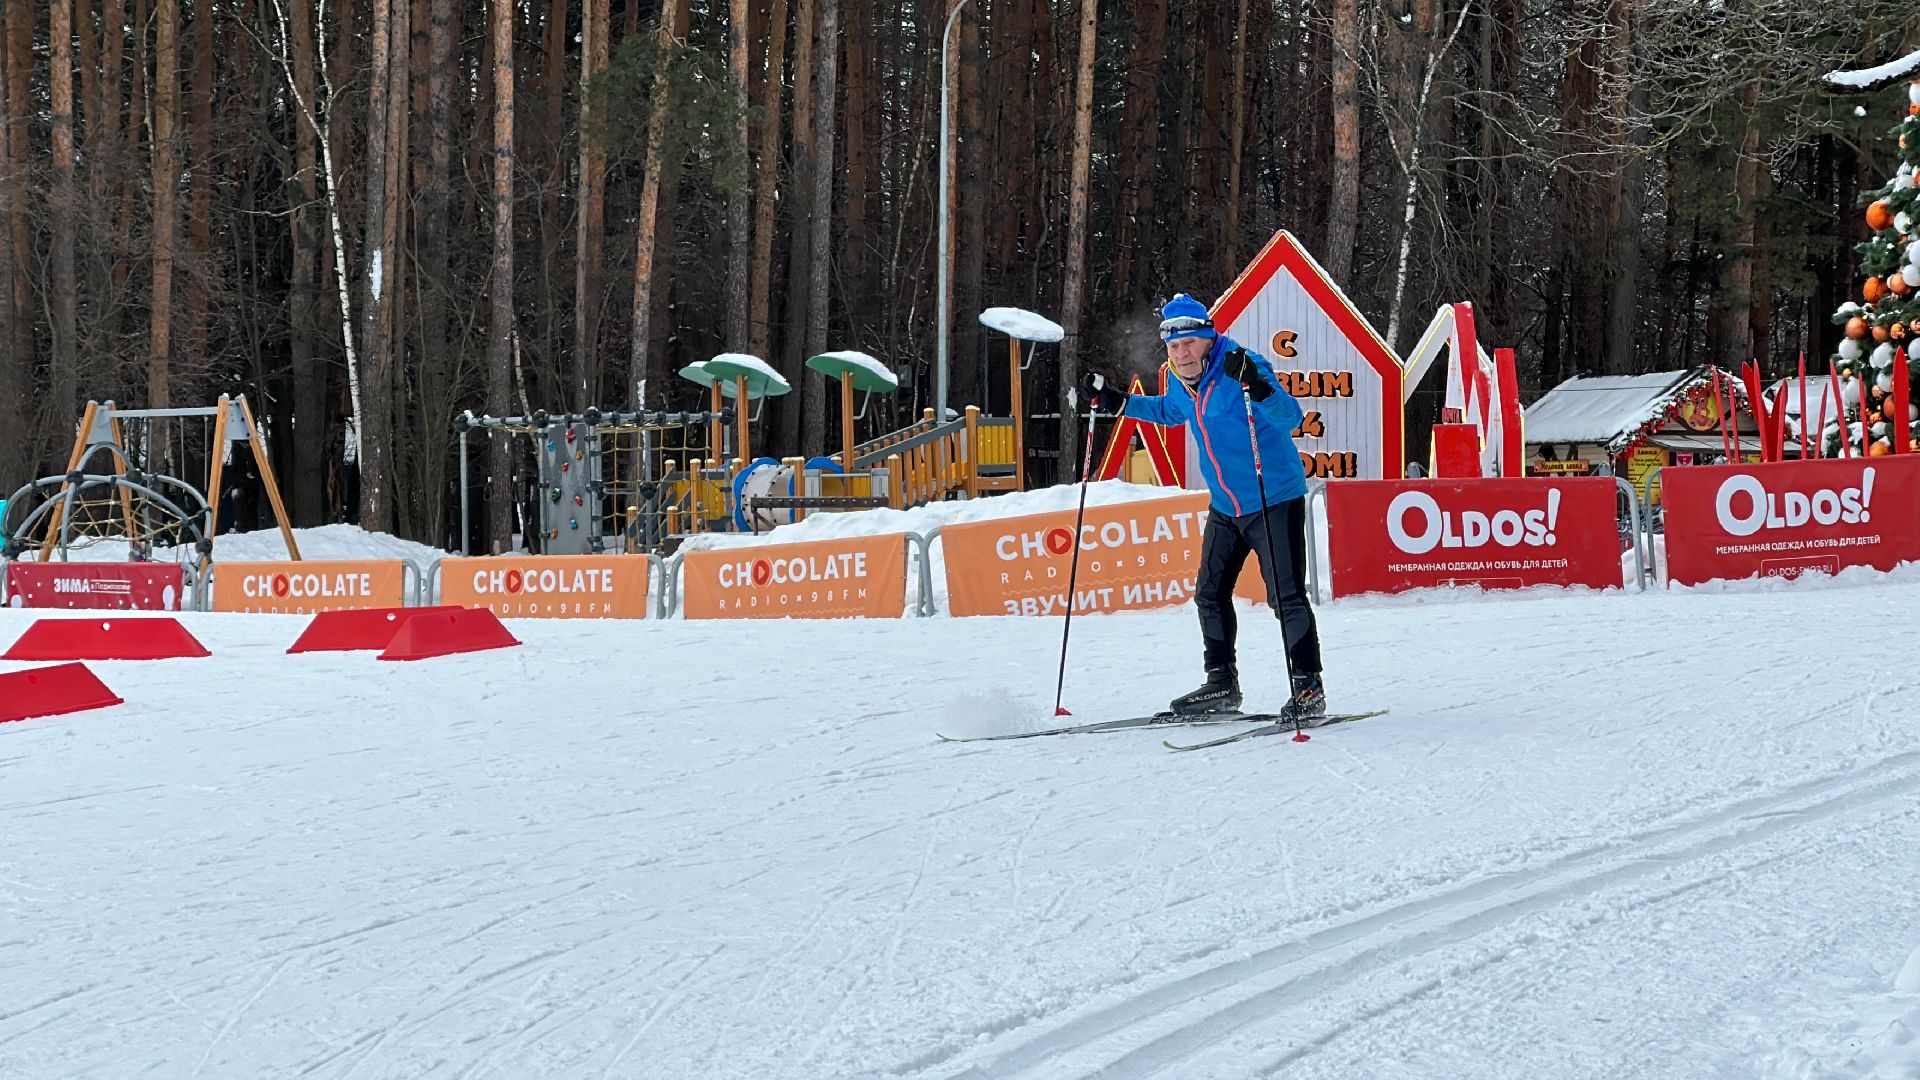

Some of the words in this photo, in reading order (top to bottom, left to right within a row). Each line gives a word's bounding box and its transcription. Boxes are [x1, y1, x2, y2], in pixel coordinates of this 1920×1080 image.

[1275, 371, 1354, 398] ВЫМ
[1299, 451, 1358, 479] ОМ!
[1716, 543, 1770, 554] МЕМБРАННАЯ
[1771, 541, 1804, 551] ОДЕЖДА
[1806, 540, 1813, 548] И
[1813, 539, 1838, 548] ОБУВЬ
[1838, 537, 1856, 546] ДЛЯ
[1856, 535, 1881, 545] ДЕТЕЙ
[718, 552, 867, 588] CHOCOLATE
[1001, 561, 1101, 584] RADO
[1388, 562, 1446, 572] МЕМБРАННАЯ
[1447, 561, 1485, 571] ОДЕЖДА
[1494, 560, 1521, 569] ОБУВЬ
[1522, 560, 1540, 569] ДЛЯ
[1541, 558, 1568, 568] ДЕТЕЙ
[53, 578, 91, 593] ЗИМА
[242, 572, 371, 598] CHOCOLATE
[473, 568, 613, 594] CHOCOLATE
[1123, 576, 1197, 605] ИНАЧ
[719, 595, 787, 609] RADIO
[1187, 689, 1231, 703] SALOMON
[1149, 715, 1211, 724] FISCHER
